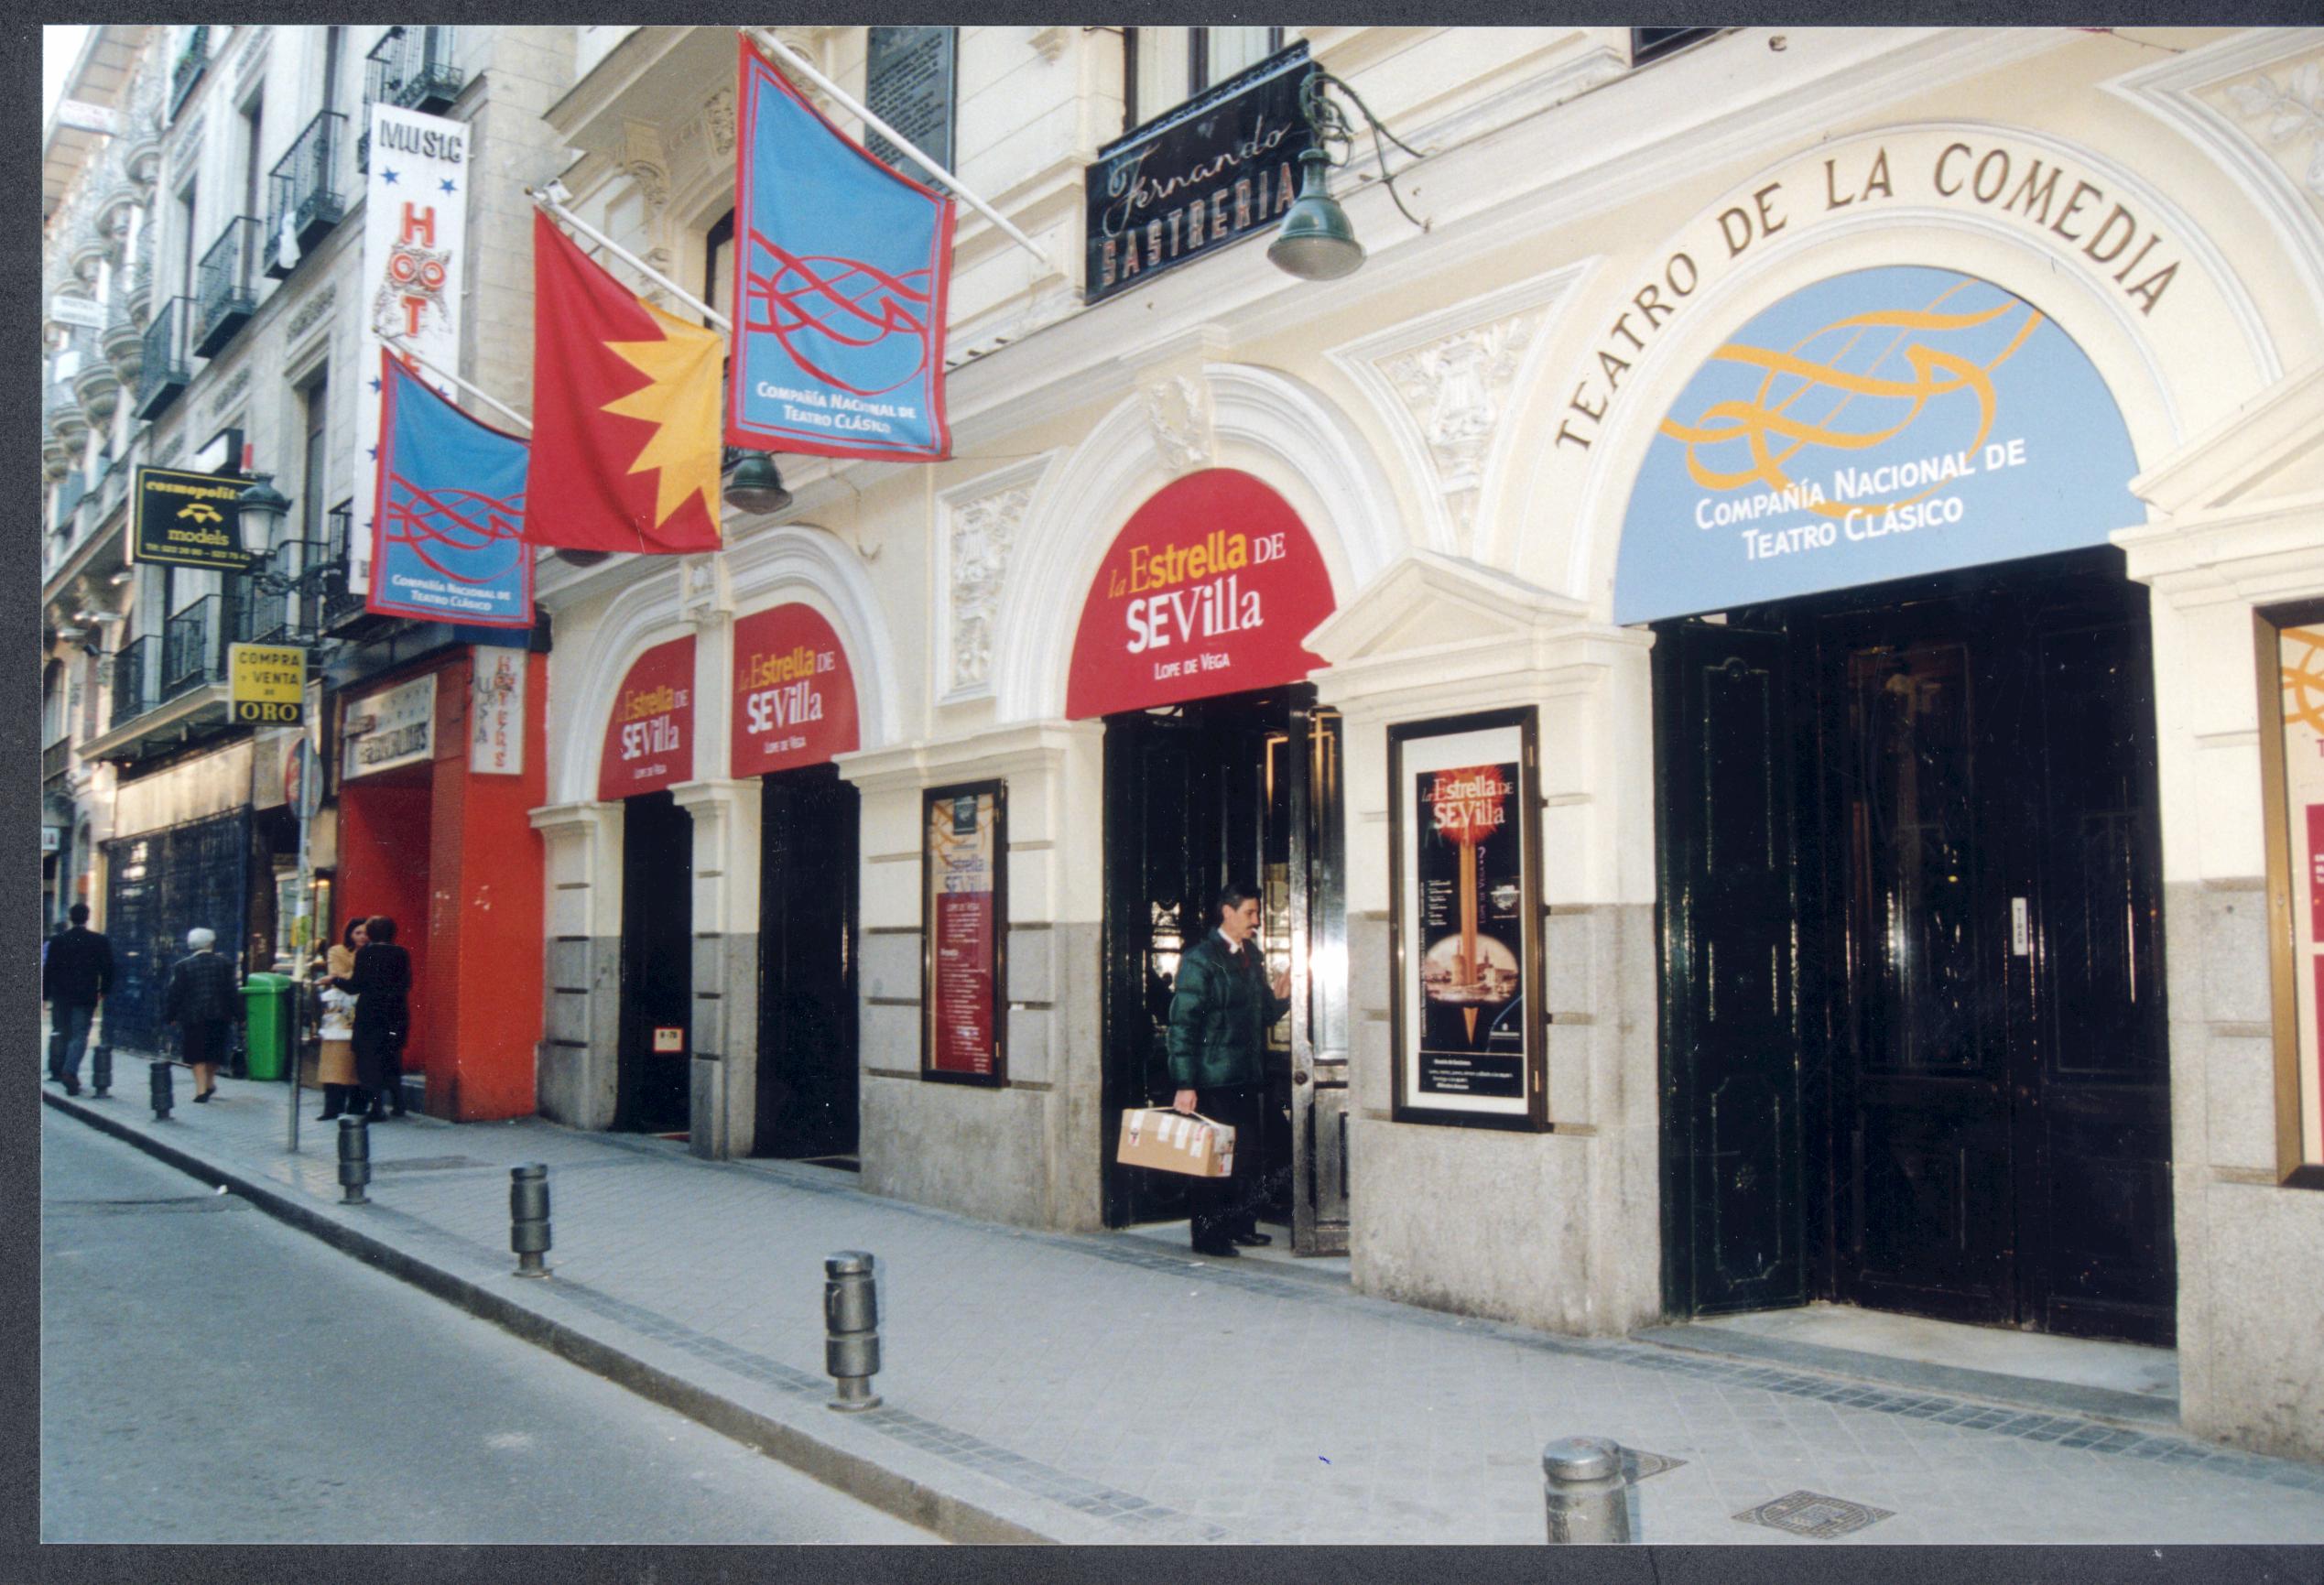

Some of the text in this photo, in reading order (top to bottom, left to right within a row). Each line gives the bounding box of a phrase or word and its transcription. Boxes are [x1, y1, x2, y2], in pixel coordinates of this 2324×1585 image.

[379, 118, 462, 164] MUSIC
[1102, 114, 1293, 238] Fernando
[1102, 161, 1296, 287] SASTRERIA
[1555, 142, 2182, 451] TEATRO DE LA COMEDIA
[783, 404, 832, 428] TEATRO
[897, 407, 917, 419] DE
[1694, 439, 2027, 530] COMPAÑÍA NACIONAL DE
[168, 527, 229, 546] models
[1742, 496, 1964, 560] TEATRO CLÁSICO
[1107, 528, 1287, 599] la Estrella DE
[1125, 573, 1265, 654] SEVilla
[239, 651, 299, 667] COMPRA
[252, 671, 298, 685] VENTA
[749, 646, 815, 689] Estrella
[817, 651, 835, 673] DE
[1154, 652, 1231, 680] LOPE DE VEGA
[240, 701, 299, 722] ORO
[625, 685, 674, 721] Estrella
[674, 689, 689, 709] DE
[747, 679, 823, 734] SEVilla
[622, 714, 679, 761] SEVilla
[1433, 774, 1496, 801] Estrella
[1497, 782, 1514, 795] DE
[1433, 798, 1505, 830] SEVilla
